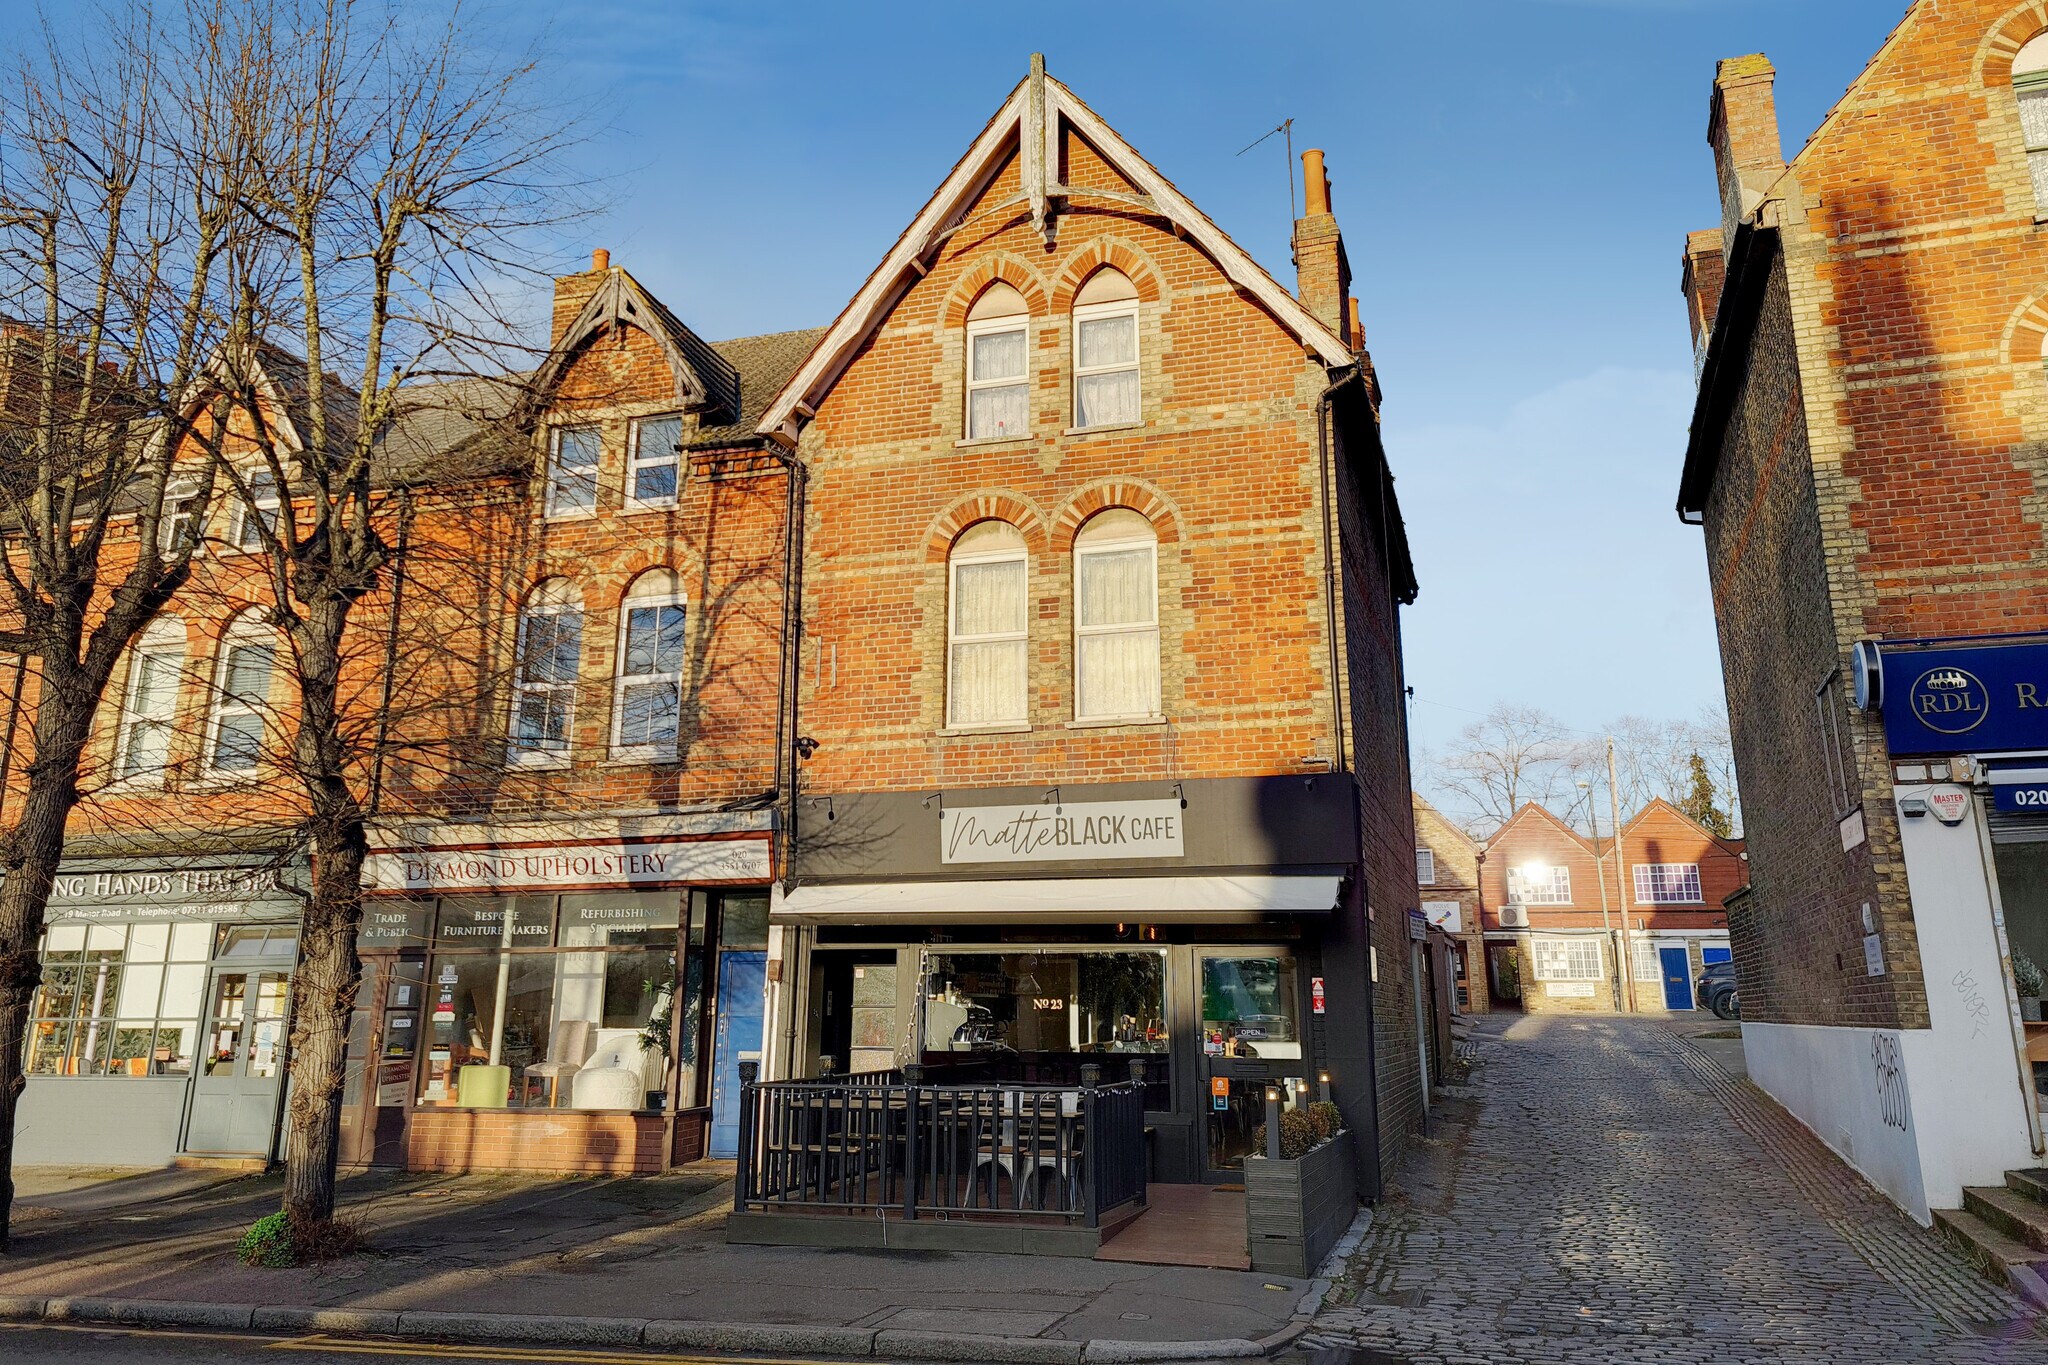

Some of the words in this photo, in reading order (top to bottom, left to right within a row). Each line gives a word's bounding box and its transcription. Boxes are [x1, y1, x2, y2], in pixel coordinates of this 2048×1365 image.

[1919, 692, 1981, 713] RDL
[2014, 682, 2048, 708] R
[1933, 794, 1964, 804] MASTER
[949, 809, 1058, 859] Matte
[1055, 815, 1127, 846] BLACK
[1131, 816, 1175, 841] CAFE
[732, 850, 747, 859] 020
[407, 859, 516, 881] DIAMOND
[525, 853, 669, 877] UPHOLSTERY
[51, 876, 87, 897] NG
[94, 873, 173, 896] HANDS
[101, 907, 121, 918] Road
[374, 913, 407, 923] TRADE
[580, 907, 661, 919] REFURBISHING
[365, 928, 375, 937] &
[377, 928, 412, 937] PUBLIC
[444, 925, 504, 936] FURNITURE
[507, 924, 549, 935] MAKERS
[1050, 998, 1063, 1010] 23
